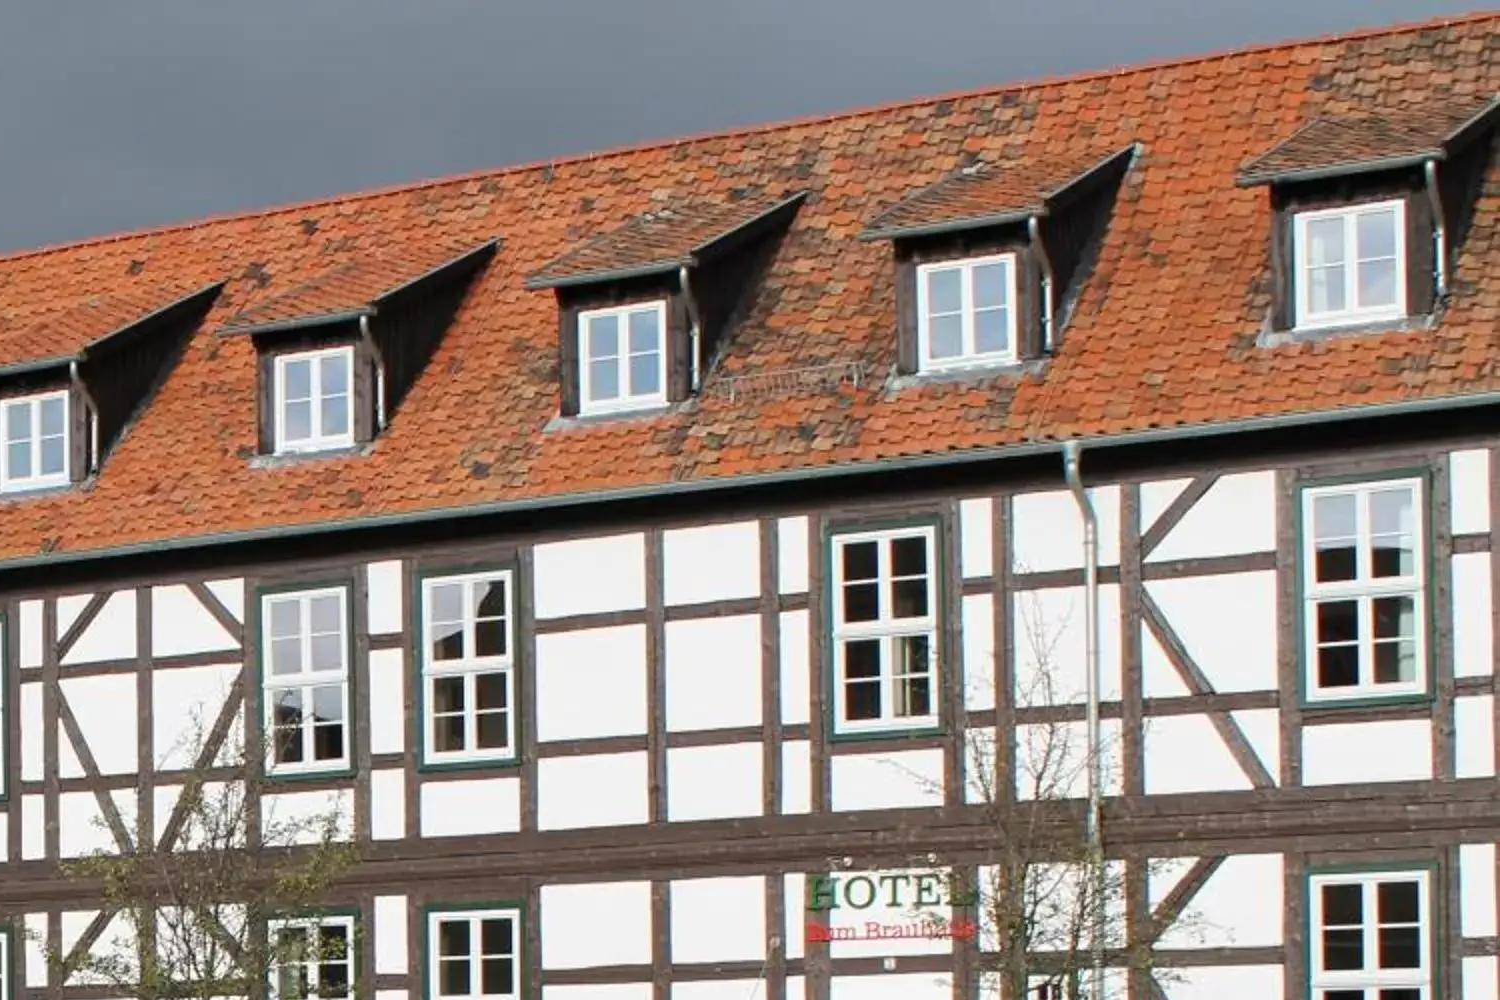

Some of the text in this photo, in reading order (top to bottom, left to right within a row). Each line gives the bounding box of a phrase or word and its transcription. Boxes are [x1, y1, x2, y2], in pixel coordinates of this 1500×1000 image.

[806, 873, 975, 911] HOTEL
[805, 918, 976, 942] um Brauha
